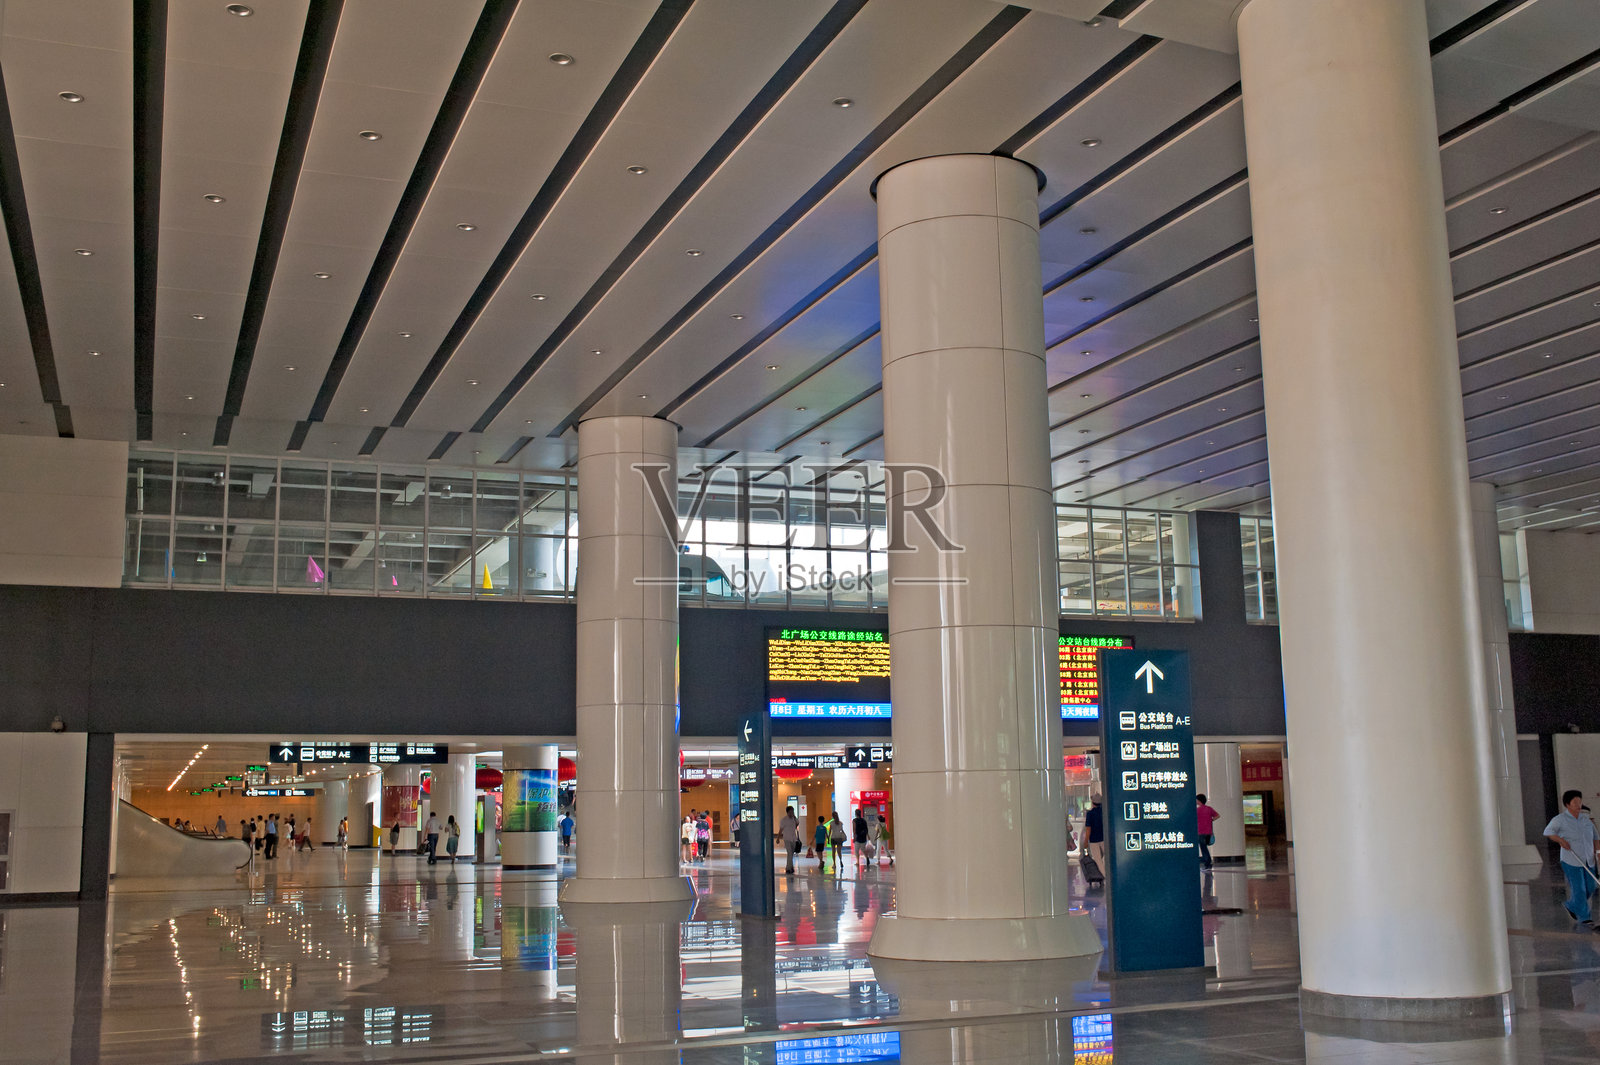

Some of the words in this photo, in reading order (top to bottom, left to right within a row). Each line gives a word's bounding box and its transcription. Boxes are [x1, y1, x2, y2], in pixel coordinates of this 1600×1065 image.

[781, 630, 883, 641] 北广场公交线路途经站名
[797, 705, 825, 716] 星期五
[829, 706, 883, 717] 农历六月初八
[1139, 712, 1173, 723] 公交站台
[1175, 716, 1191, 726] A-E
[1140, 742, 1179, 752] 北广场出口
[1141, 772, 1188, 782] 自行车停放处
[1143, 802, 1168, 812] 咨询处
[1144, 832, 1185, 843] 残疾人站台
